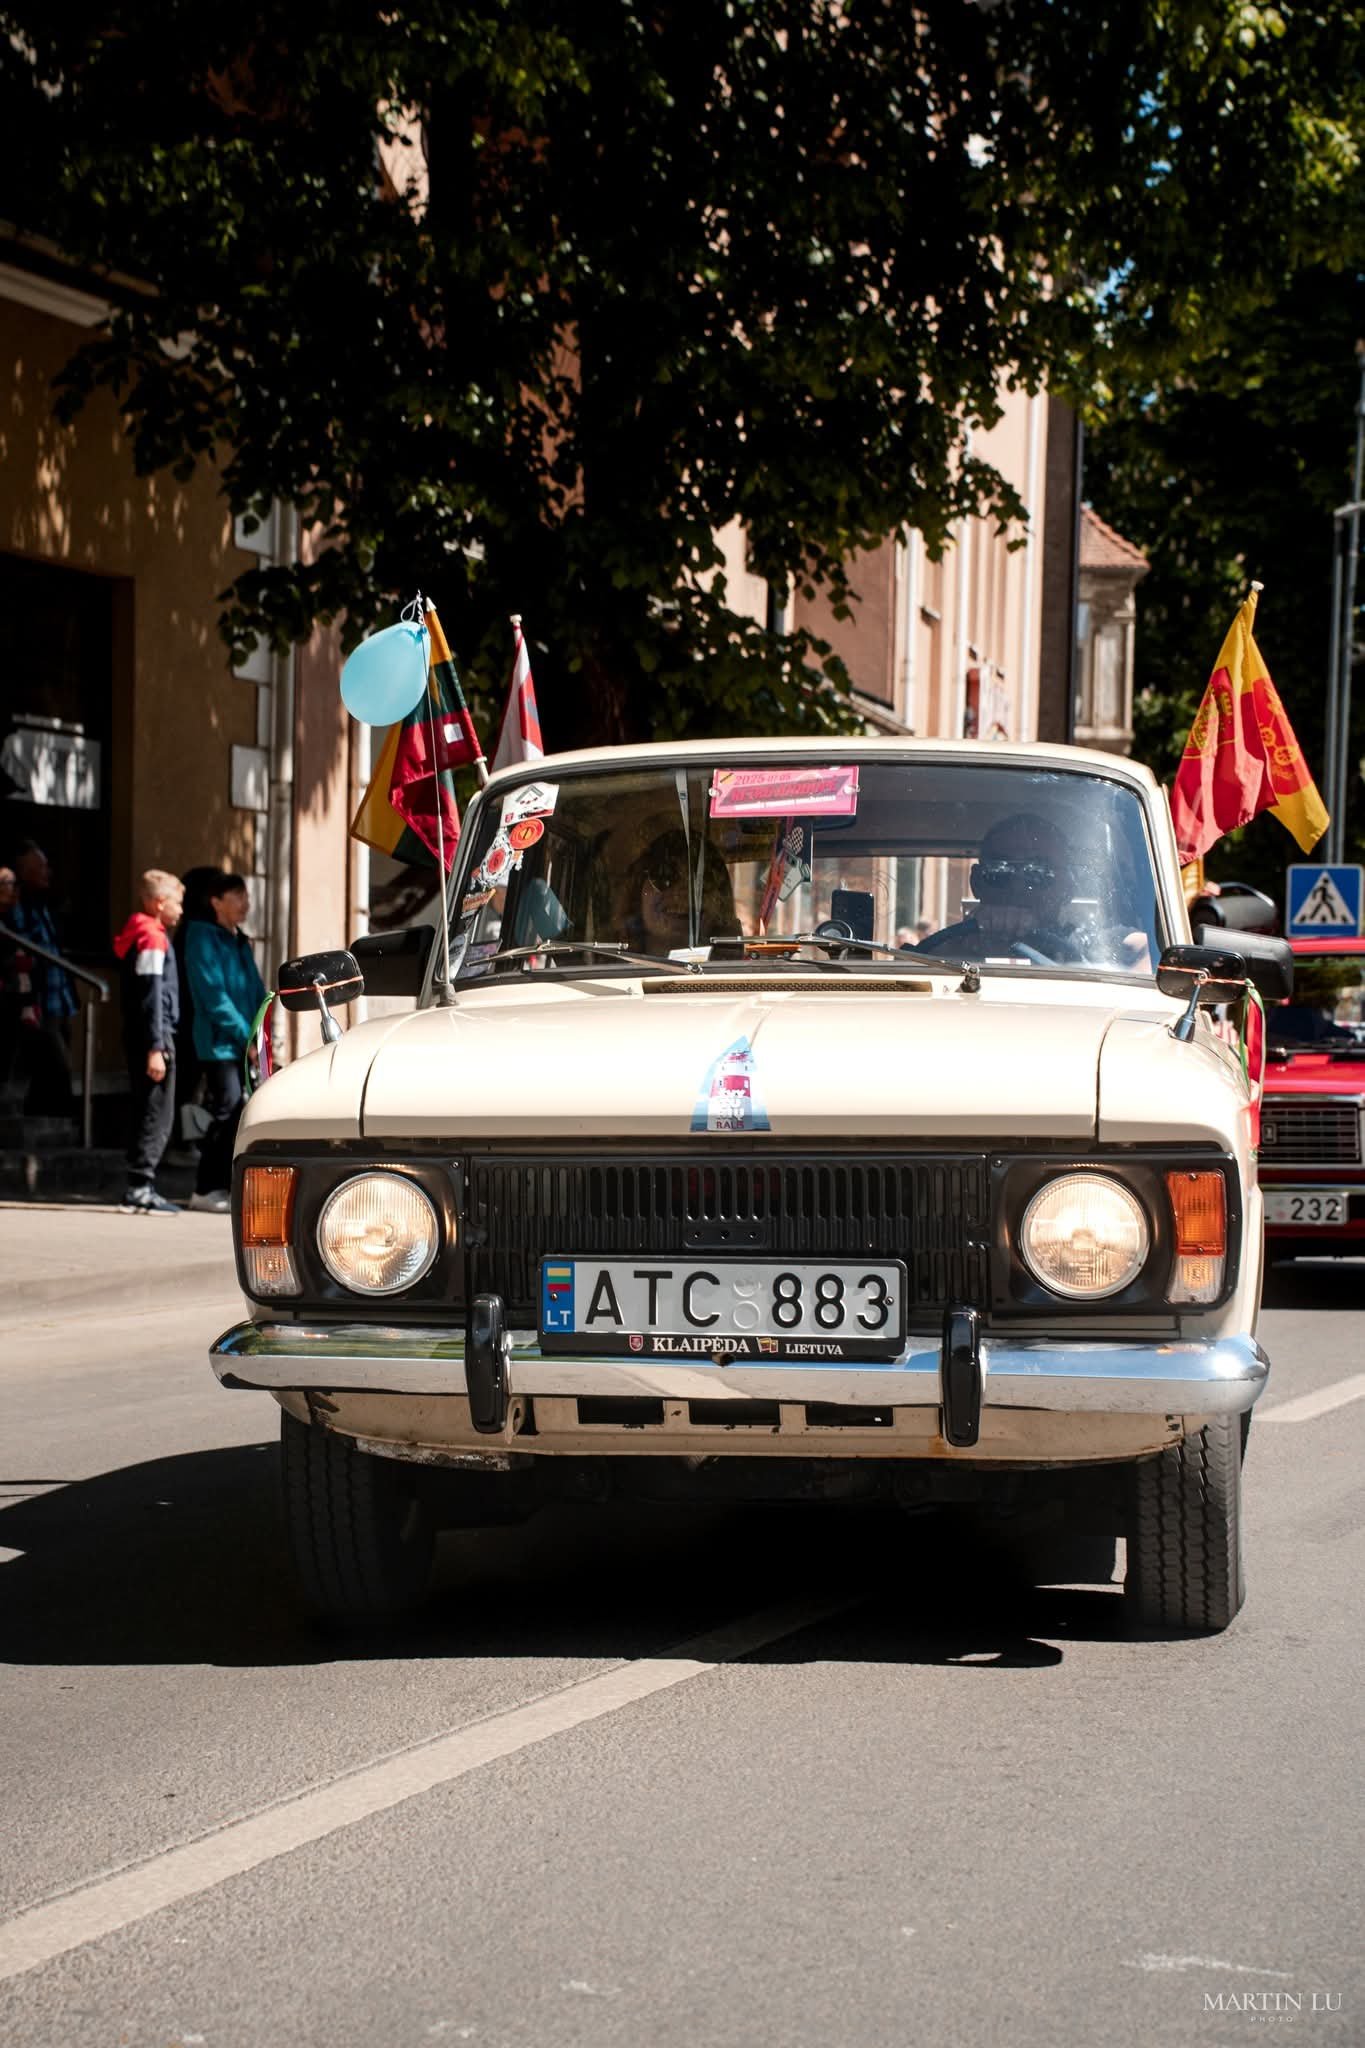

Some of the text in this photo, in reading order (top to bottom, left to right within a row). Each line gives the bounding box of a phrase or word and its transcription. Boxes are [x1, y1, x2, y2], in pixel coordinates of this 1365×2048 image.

[1290, 1198, 1340, 1221] 232
[584, 1269, 889, 1331] ATC 883
[545, 1309, 572, 1327] LT
[652, 1336, 844, 1355] KLAIPĖDA LIETUVA
